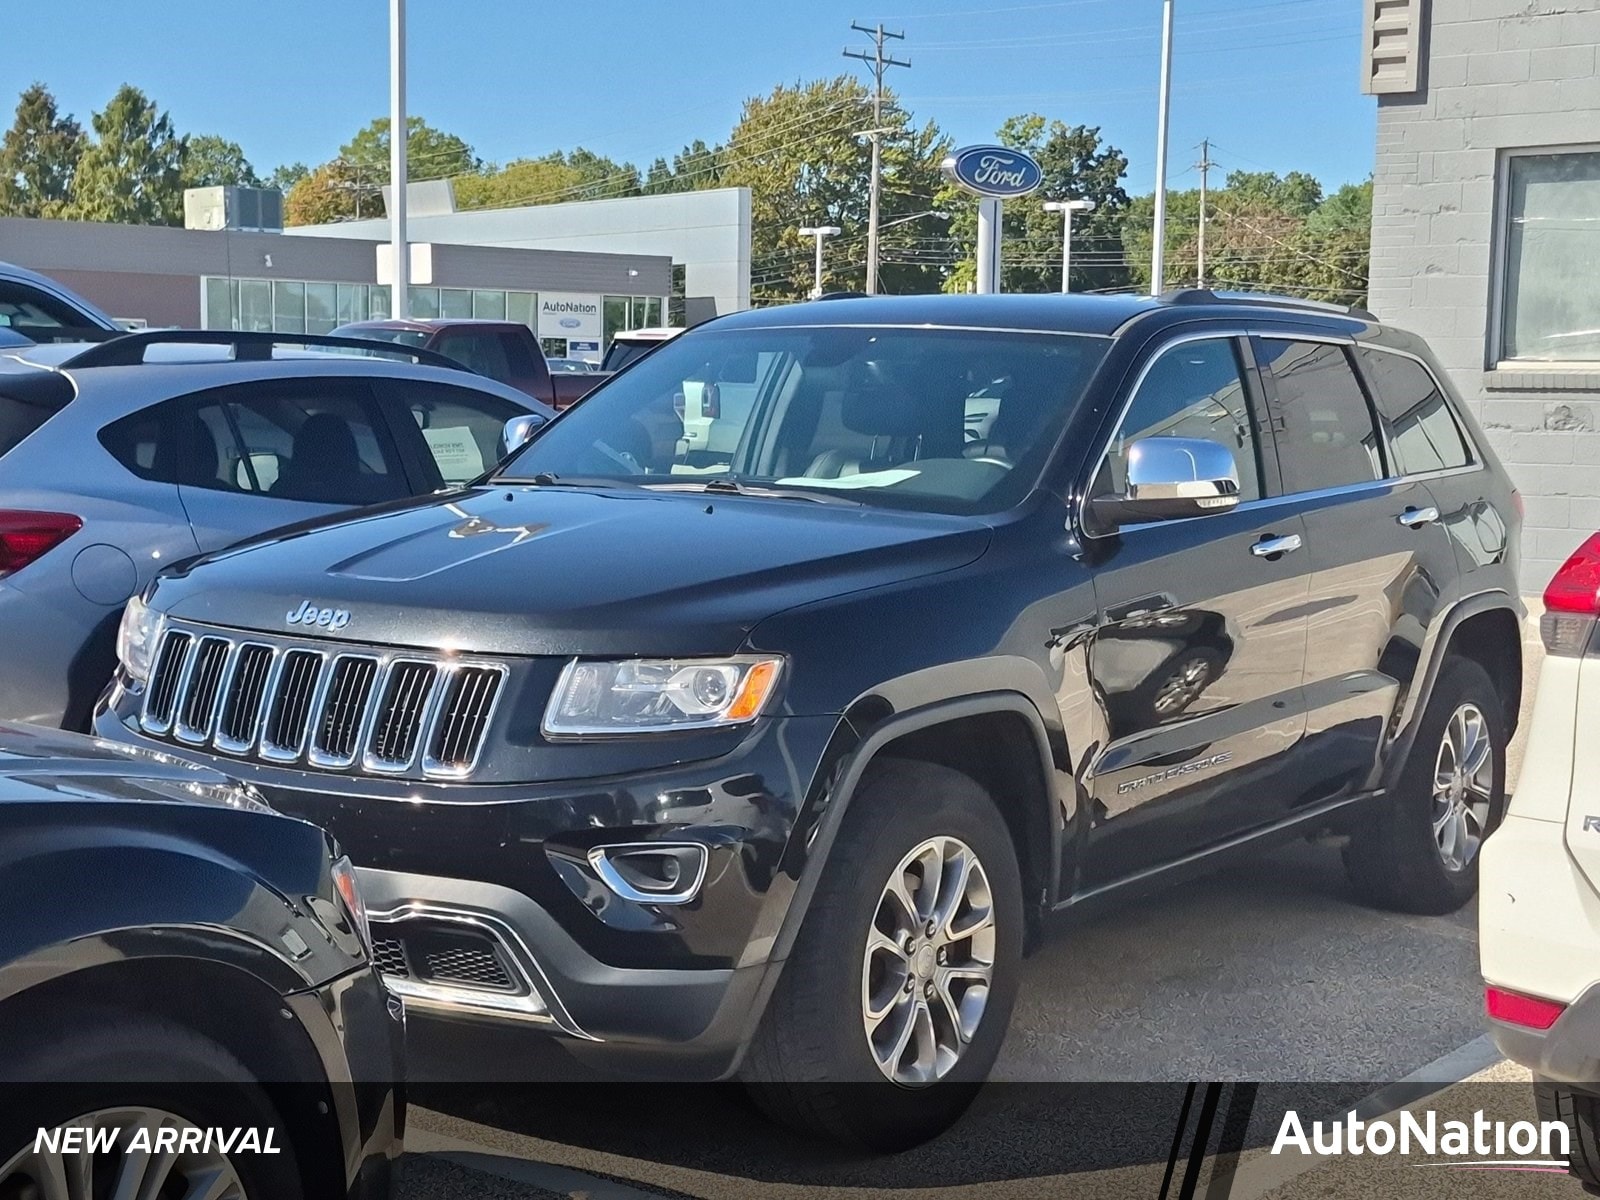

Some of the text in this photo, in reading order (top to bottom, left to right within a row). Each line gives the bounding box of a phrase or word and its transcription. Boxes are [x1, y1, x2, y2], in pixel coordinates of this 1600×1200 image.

[974, 156, 1026, 187] Ford
[543, 301, 596, 312] AutoNation
[286, 600, 351, 632] Jeep
